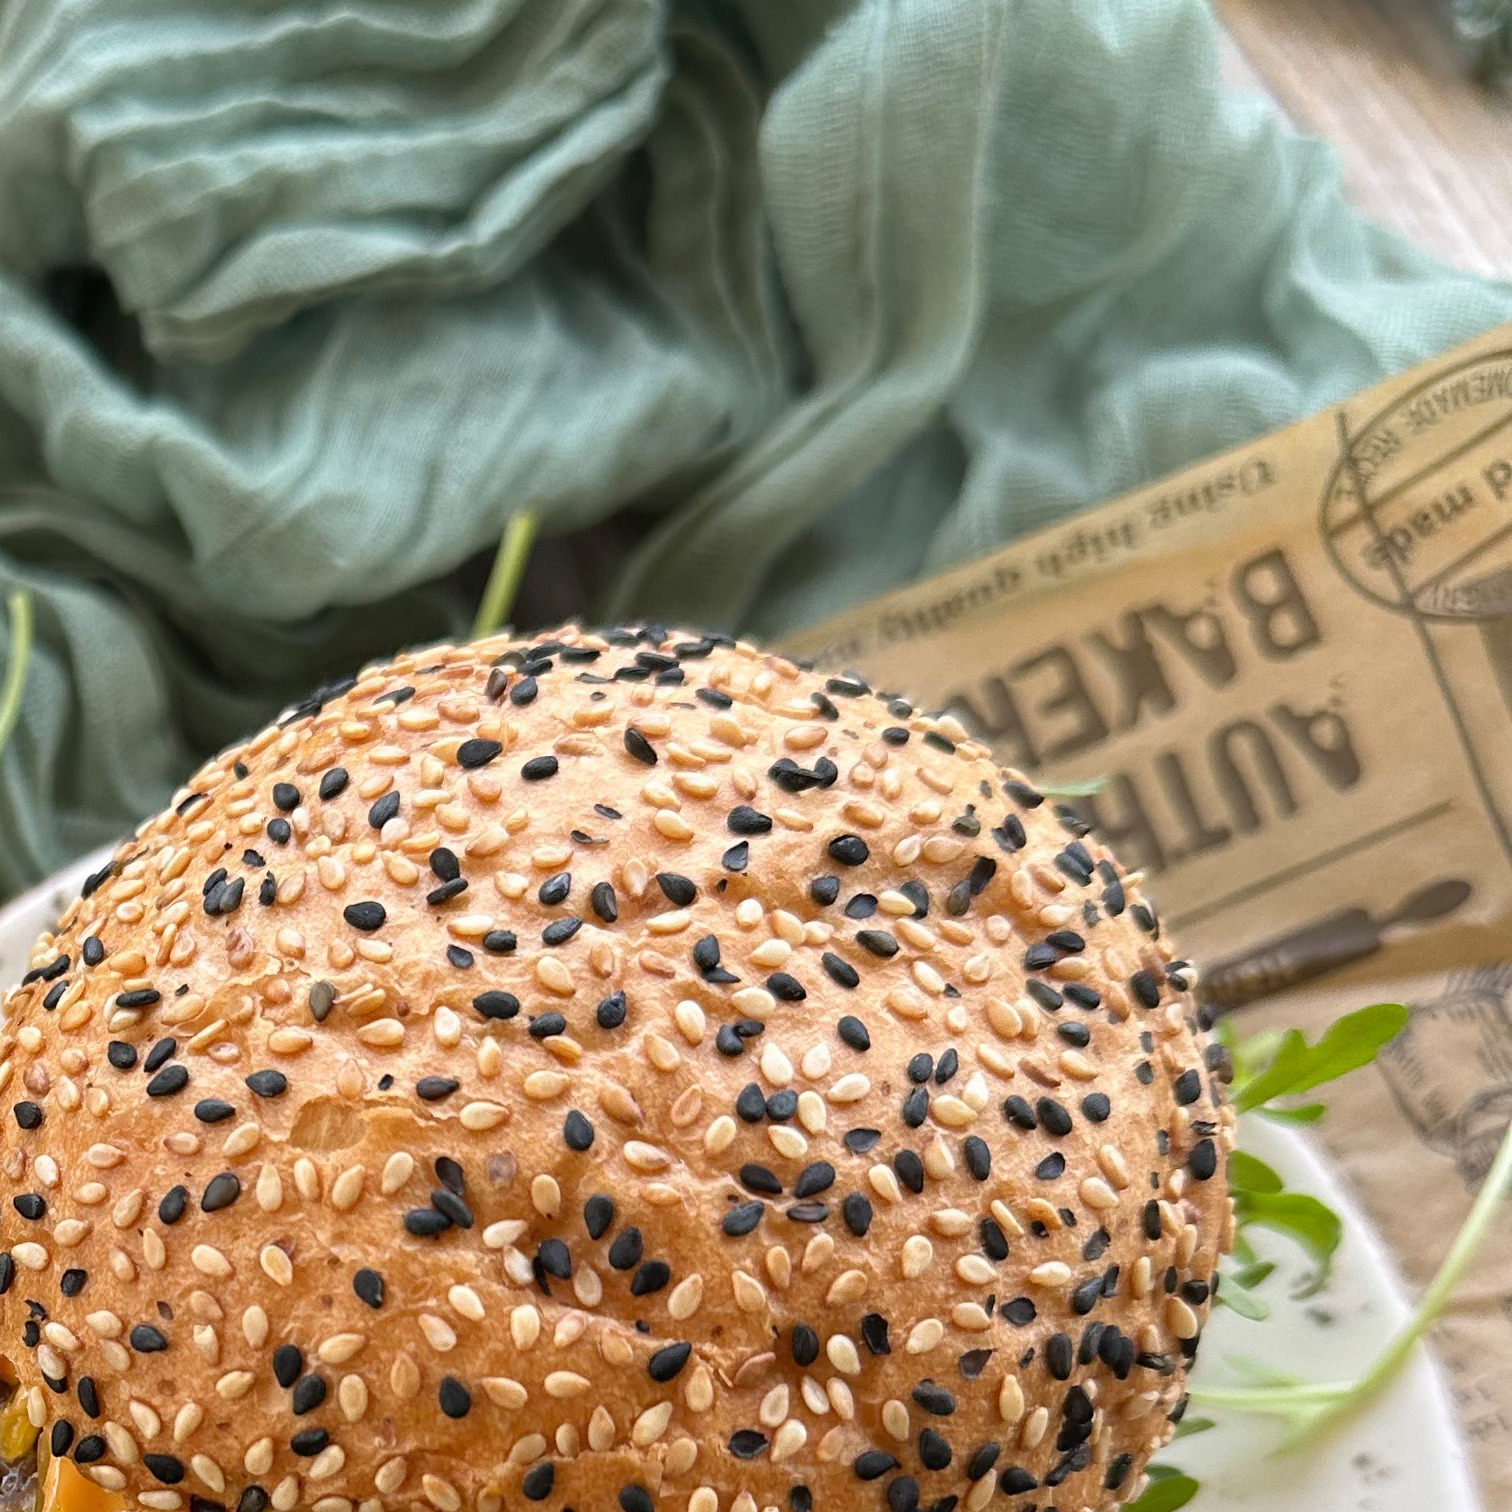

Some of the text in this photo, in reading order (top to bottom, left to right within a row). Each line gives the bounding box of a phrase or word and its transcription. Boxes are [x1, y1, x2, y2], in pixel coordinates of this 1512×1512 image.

[877, 458, 1276, 646] Using high quality
